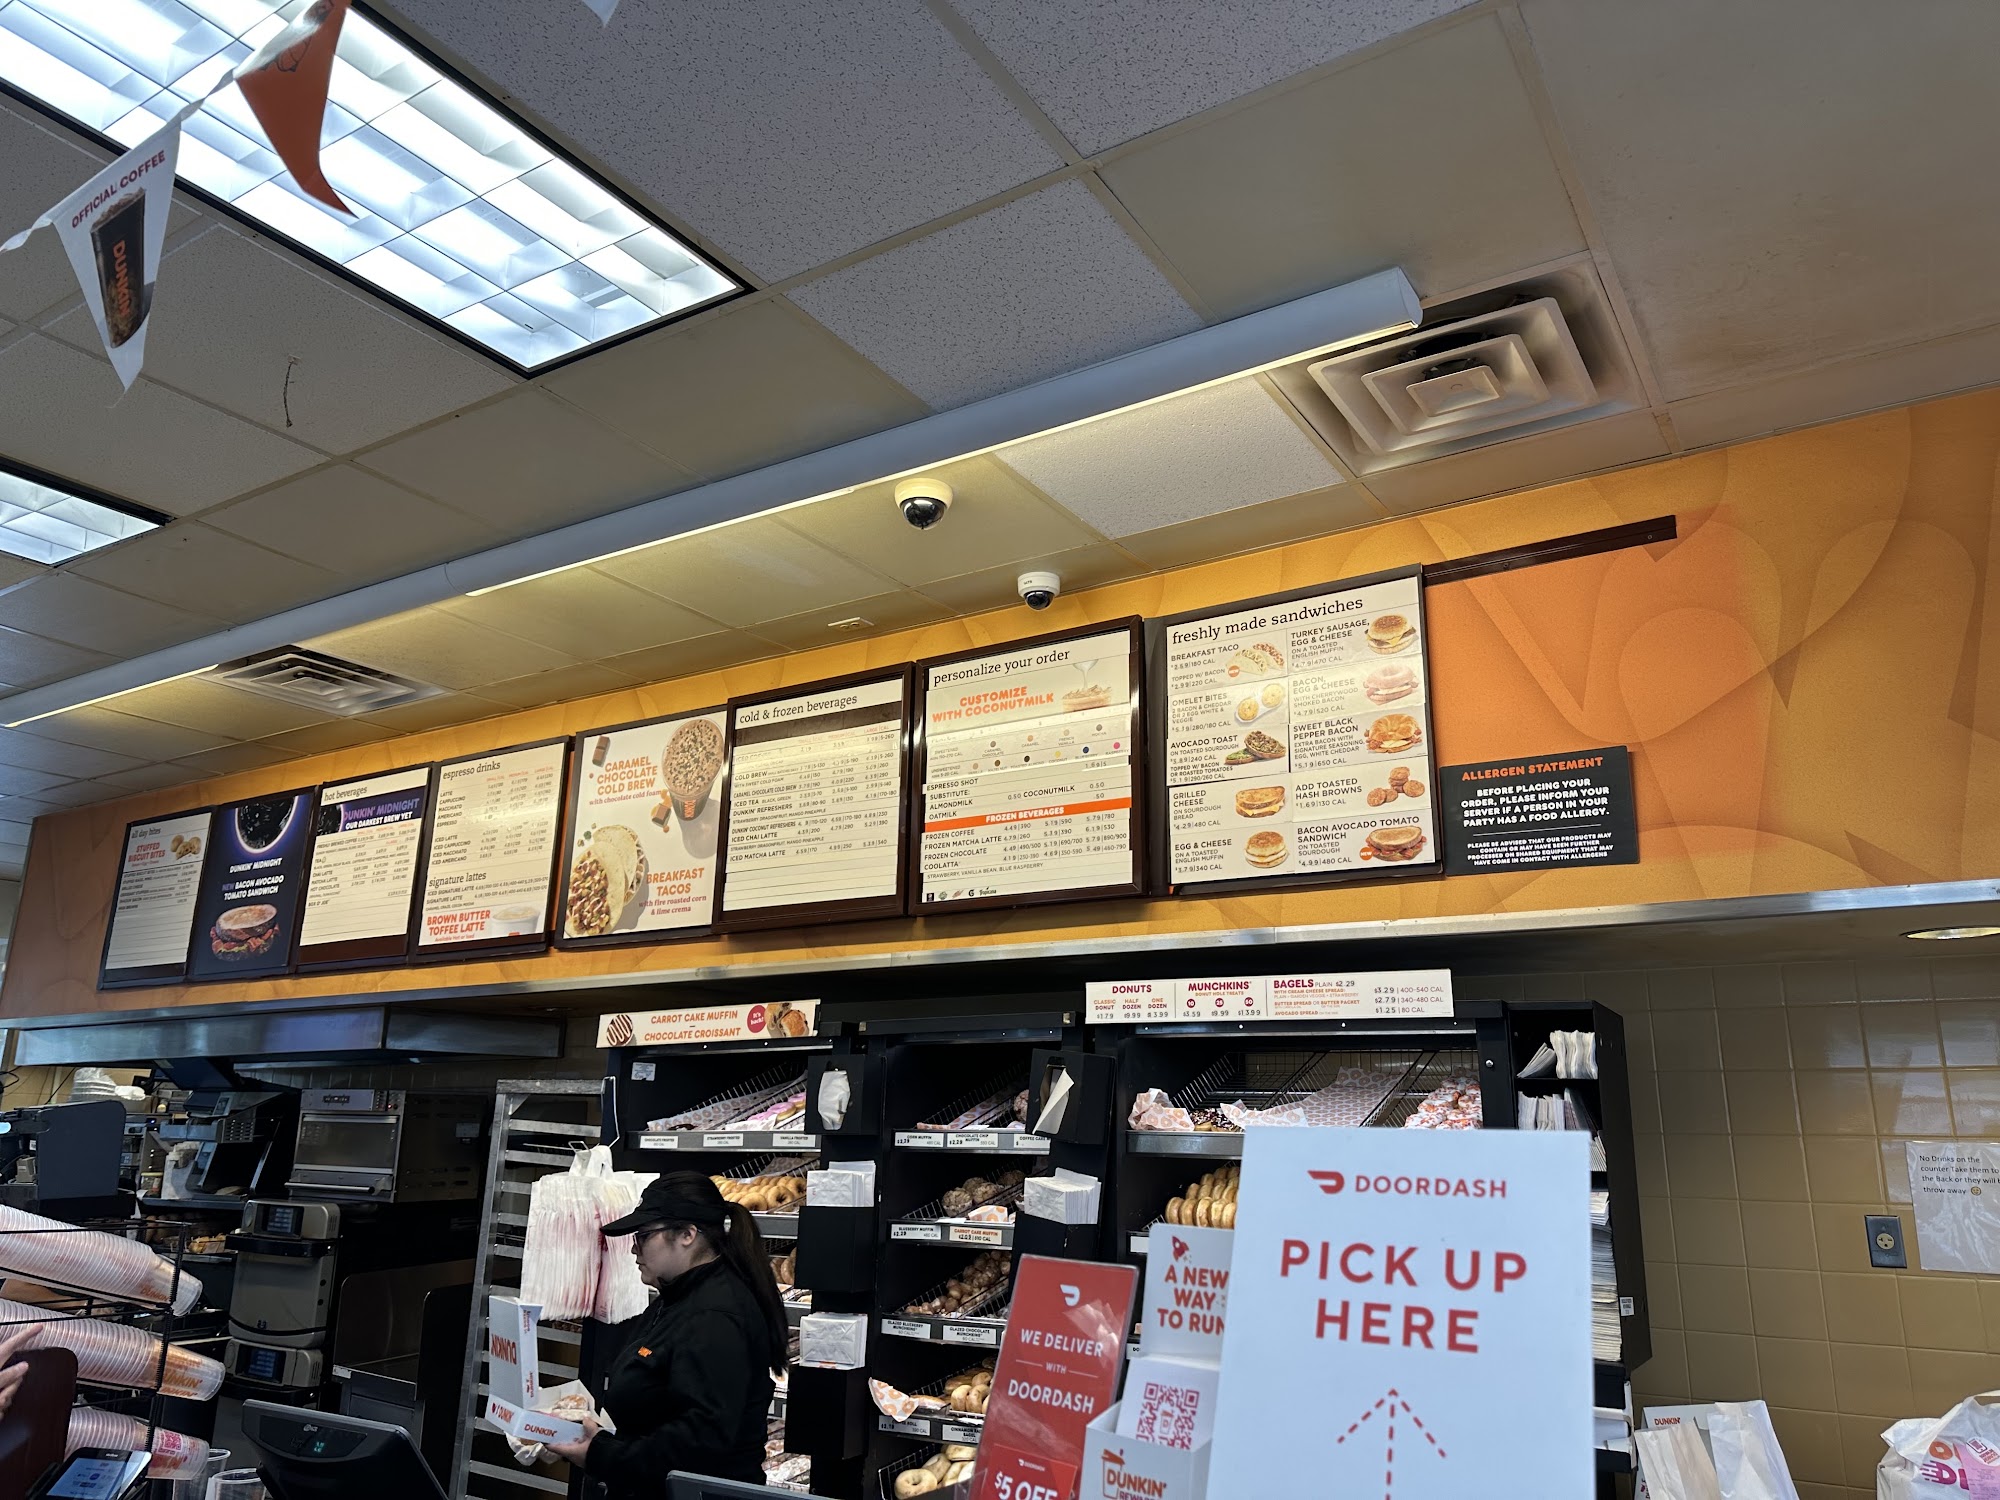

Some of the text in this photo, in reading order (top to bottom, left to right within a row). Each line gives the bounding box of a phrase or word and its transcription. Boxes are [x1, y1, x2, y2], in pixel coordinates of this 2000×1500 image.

[72, 150, 165, 228] OFFICIAL COFFEE
[1173, 599, 1363, 644] freshly made sandwiches
[1291, 619, 1369, 639] TURKEY SAUSAGE,
[1292, 638, 1308, 646] EGG
[1319, 630, 1352, 641] CHEESE
[1171, 644, 1239, 661] BREAKFAST TACO
[934, 650, 1070, 687] personalize your order
[960, 686, 1028, 706] CUSTOMIZE
[740, 696, 858, 723] cold & frozen beverages
[932, 693, 1054, 722] WITH COCONUTMILK
[1294, 718, 1353, 732] SWEET BLACK
[1294, 725, 1358, 740] PEPPER BACON
[1171, 735, 1238, 748] AVOCADO TOAST
[1205, 744, 1239, 752] SOURDOUGH
[443, 768, 474, 780] espresso
[477, 761, 500, 773] drinks
[605, 756, 651, 772] CARAMEL
[1462, 757, 1603, 781] ALLERGEN STATEMENT
[597, 766, 658, 784] CHOCOLATE
[598, 778, 655, 795] COLD BREW
[927, 778, 978, 791] ESPRESSO SHOT
[1477, 778, 1591, 797] BEFORE PLACING YOUR
[324, 787, 367, 801] hot beverages
[930, 785, 1075, 810] ALMONDMILK COCONUTMILK
[1461, 787, 1609, 808] ORDER, PLEASE INFORM YOUR
[344, 798, 420, 820] DUNKIN' MIDNIGHT
[929, 811, 957, 820] OATMILK
[986, 807, 1064, 822] FROZEN BEVERAGES
[1464, 807, 1500, 817] SERVER
[1514, 805, 1521, 813] A
[1524, 801, 1563, 812] PERSON
[1566, 800, 1576, 808] IN
[1579, 797, 1608, 807] YOUR
[345, 811, 413, 830] OUR DARKEST BREW YET
[1298, 816, 1419, 834] BACON AVOCADO TOMATO
[1464, 818, 1495, 827] PARTY
[1497, 816, 1517, 824] HAS
[1529, 812, 1558, 822] FOOD
[1560, 808, 1609, 819] ALLERGY.
[1298, 832, 1346, 843] SANDWICH
[1561, 834, 1596, 842] PRODUCTS
[255, 875, 284, 886] AVOCADO
[429, 872, 486, 888] signature lattes
[647, 868, 704, 884] BREAKFAST
[248, 885, 278, 897] SANDWICH
[657, 883, 691, 896] TACOS
[427, 910, 490, 926] BROWN BUTTER
[429, 922, 485, 936] TOFFEE LATTE
[1112, 984, 1152, 993] DONUTS
[1188, 981, 1250, 991] MUNCHKINS
[1274, 979, 1314, 988] BAGELS
[651, 1011, 738, 1024] CARROT CAKE MUFFIN
[750, 1017, 764, 1025] back!
[645, 1028, 741, 1041] CHOCOLATE CROISSANT
[1355, 1175, 1506, 1198] DOORDASH
[1281, 1239, 1527, 1293] PICK UP
[1165, 1264, 1229, 1290] A NEW
[1174, 1288, 1216, 1310] WAY
[1157, 1308, 1224, 1335] TO RUN
[1316, 1298, 1478, 1353] HERE
[1021, 1328, 1103, 1357] WE DELIVER
[1046, 1362, 1067, 1374] WITH
[1008, 1380, 1094, 1414] DOORDASH
[1654, 1417, 1680, 1425] DUNKIN'
[525, 1424, 557, 1437] DUNKIN'
[995, 1471, 1013, 1500] $5
[1107, 1469, 1167, 1498] DUNKIN'
